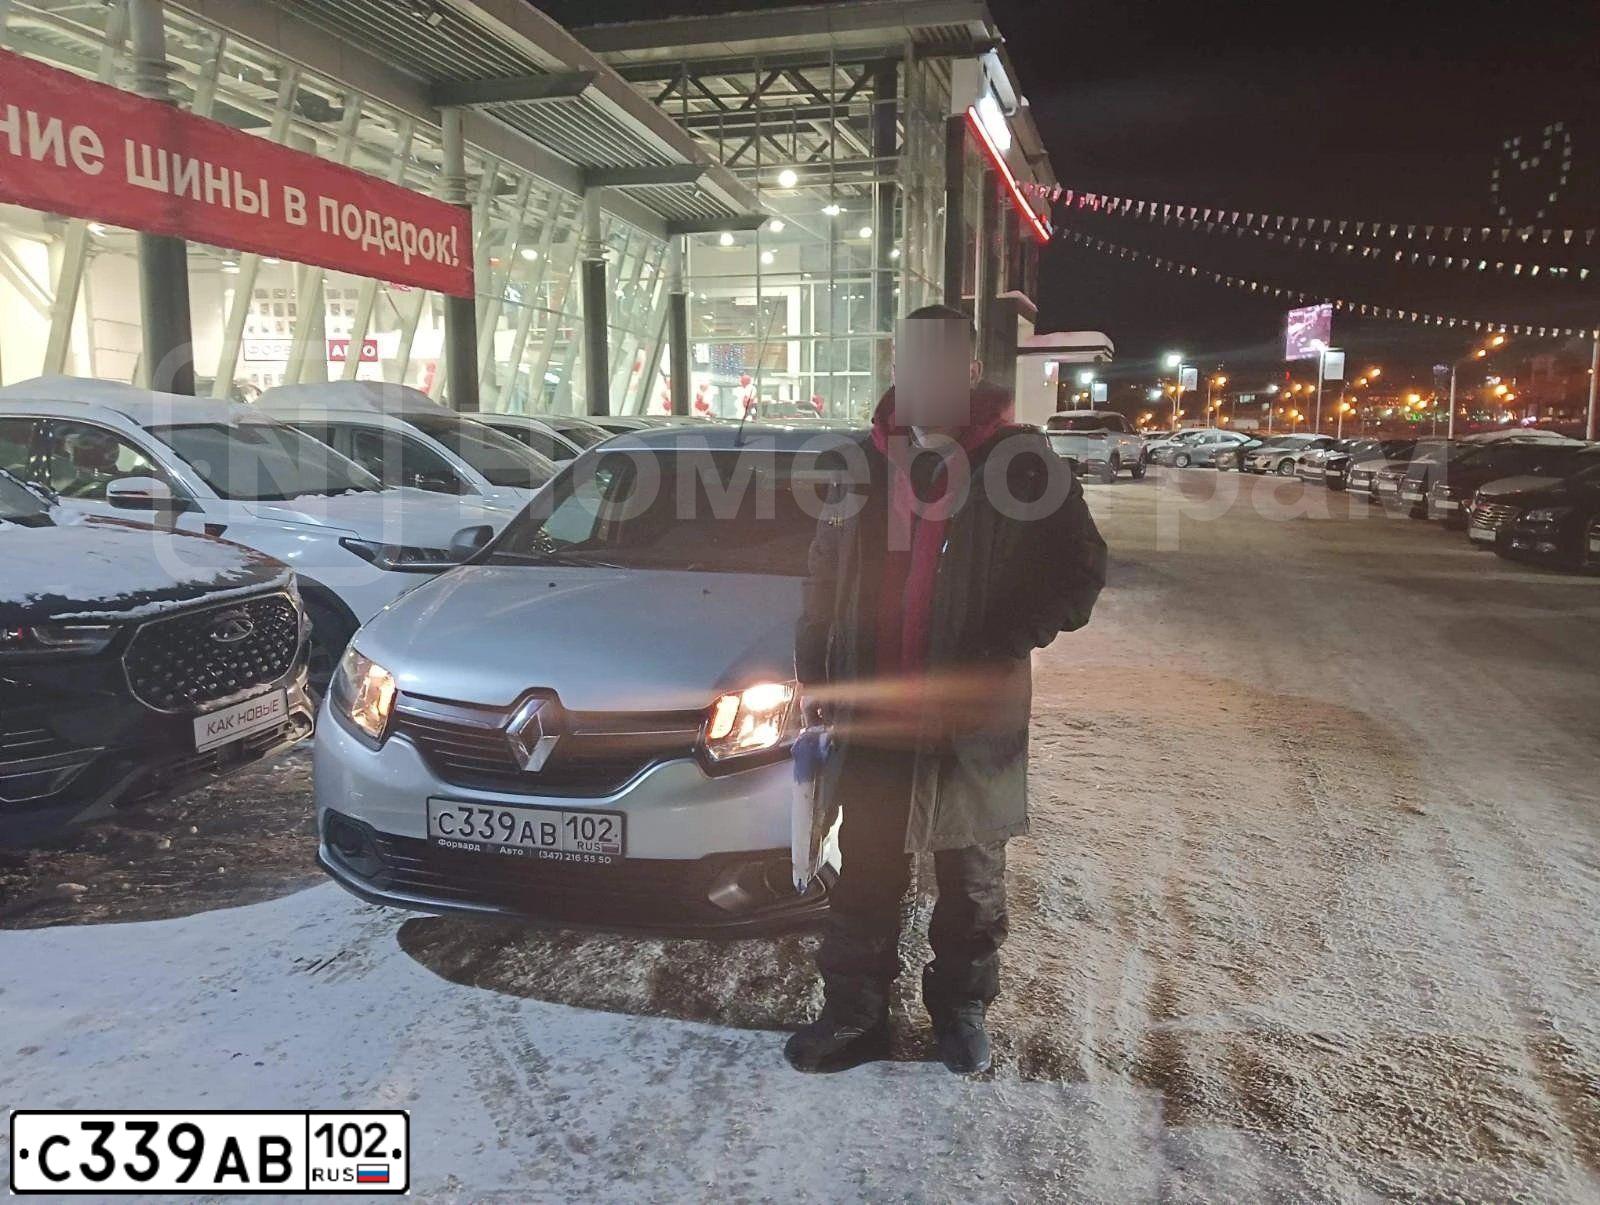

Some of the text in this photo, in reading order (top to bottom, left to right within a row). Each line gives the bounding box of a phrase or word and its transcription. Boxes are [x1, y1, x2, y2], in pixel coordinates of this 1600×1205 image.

[124, 138, 270, 218] шины
[283, 185, 308, 227] в
[318, 195, 460, 267] подарок!
[206, 700, 280, 736] КАК НОВЫЕ
[438, 806, 614, 847] С339АВ 102
[438, 838, 524, 856] Форвард Авто
[576, 841, 601, 851] RUS
